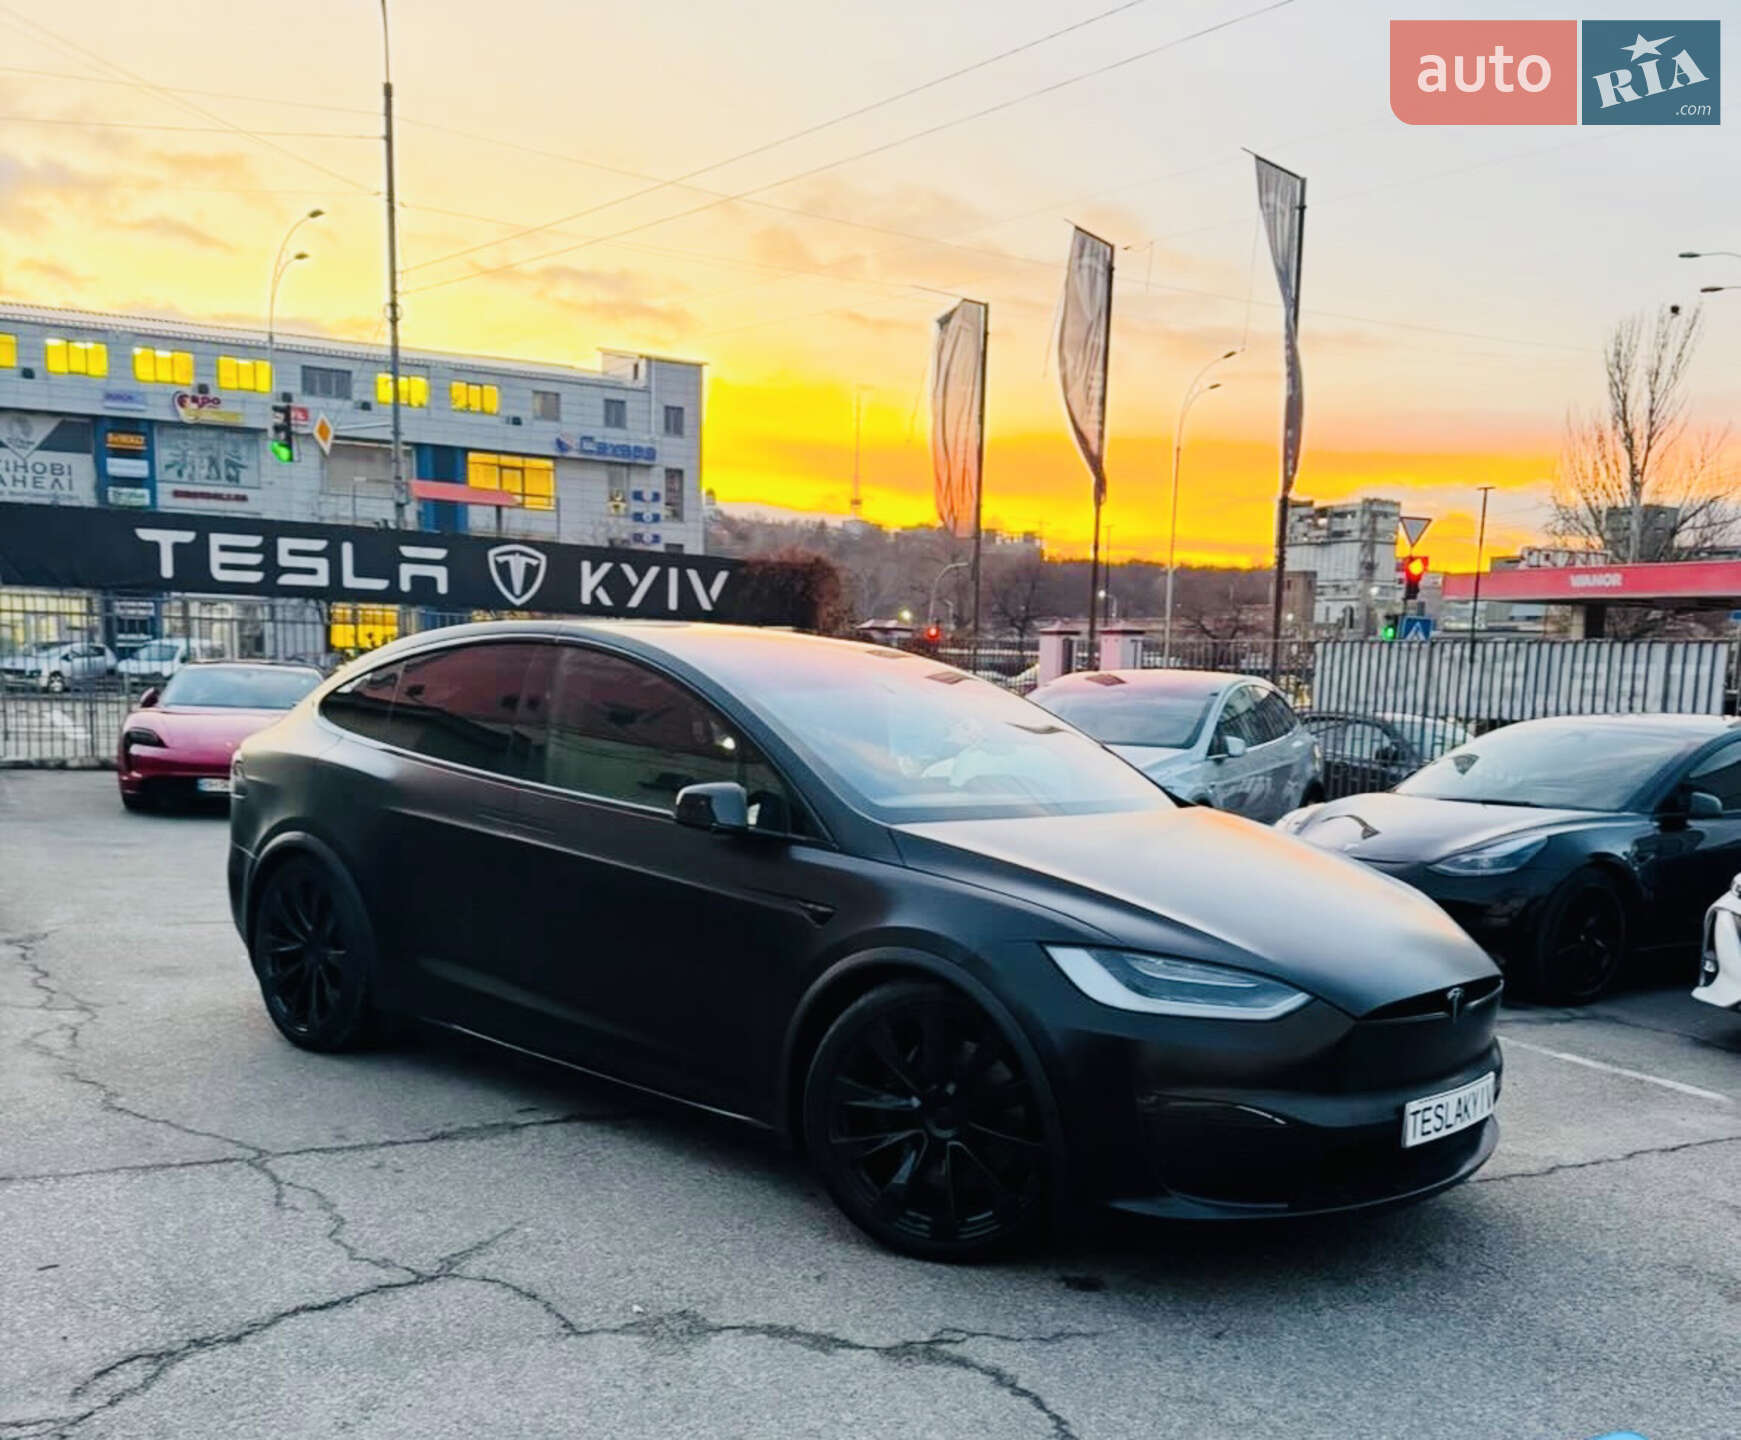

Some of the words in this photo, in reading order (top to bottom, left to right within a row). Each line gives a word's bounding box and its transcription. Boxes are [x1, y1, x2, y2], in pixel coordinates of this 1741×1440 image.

[0, 459, 72, 476] ІНОВІ
[135, 528, 448, 595] TESLA
[580, 559, 730, 611] KYIV
